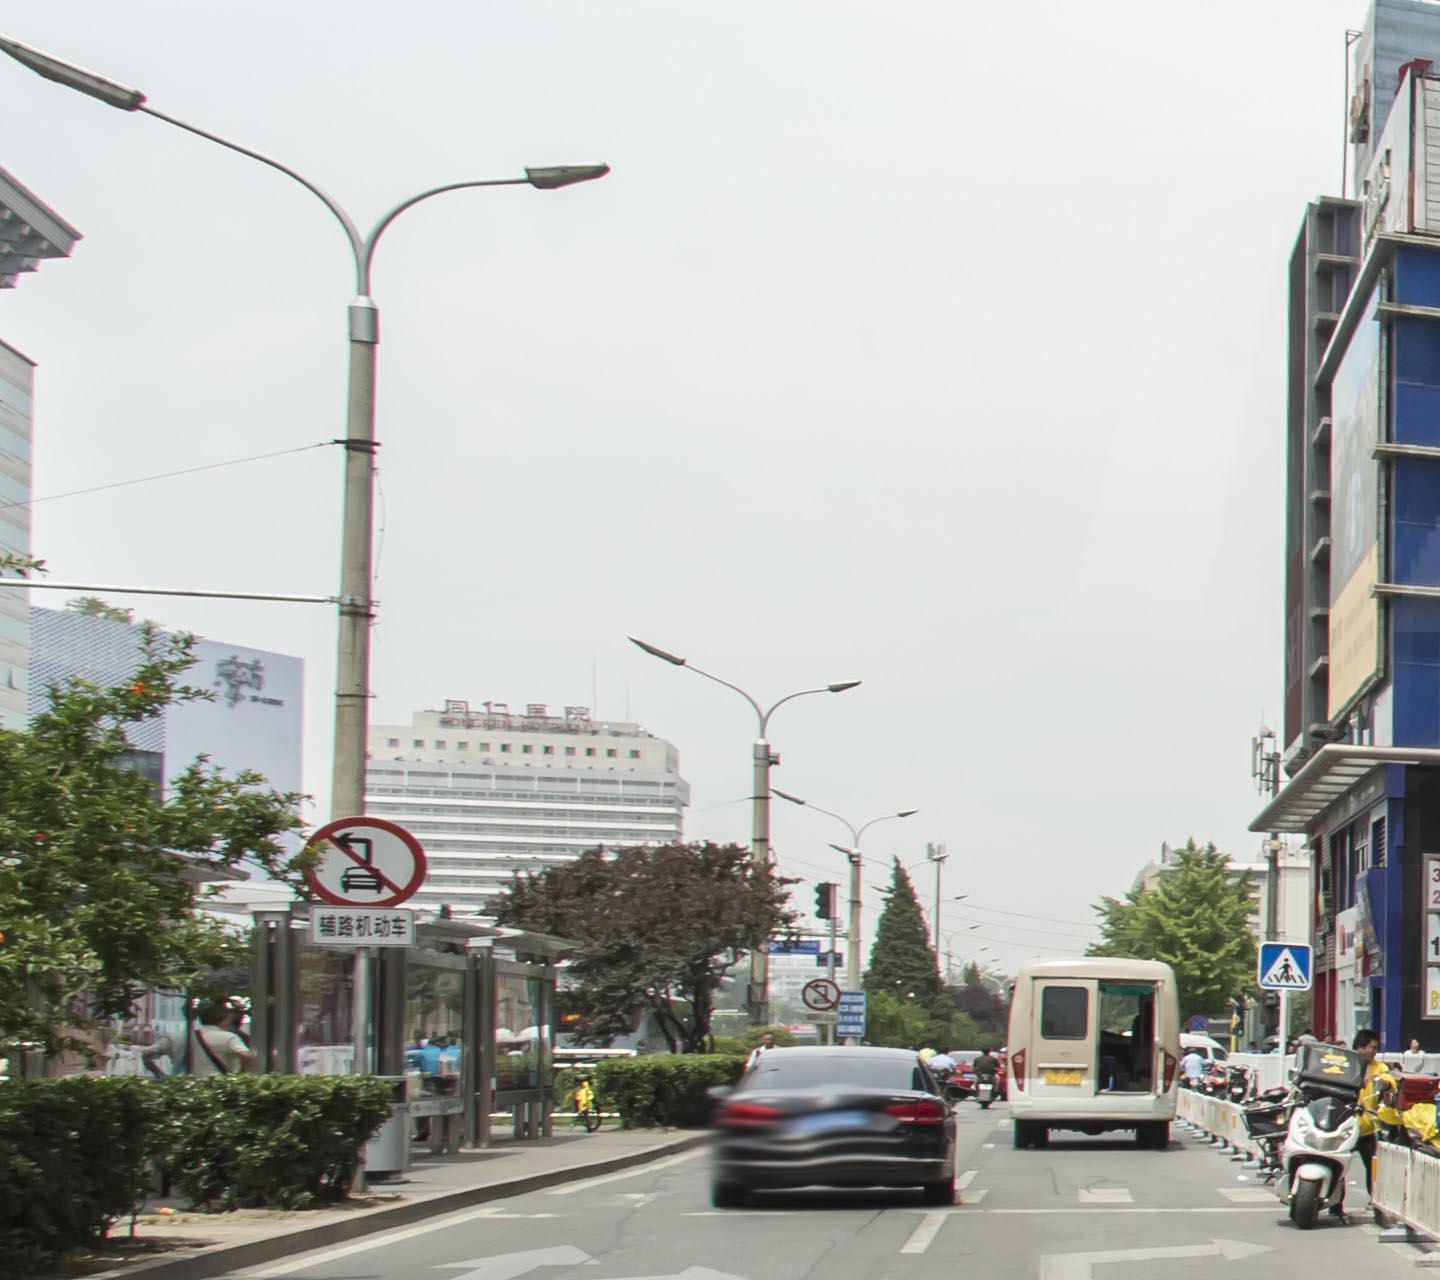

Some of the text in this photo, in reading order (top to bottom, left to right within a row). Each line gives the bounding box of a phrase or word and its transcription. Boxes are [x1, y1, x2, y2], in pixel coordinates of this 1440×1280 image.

[444, 698, 592, 722] 同仁医院
[319, 913, 407, 938] 辅路机动车
